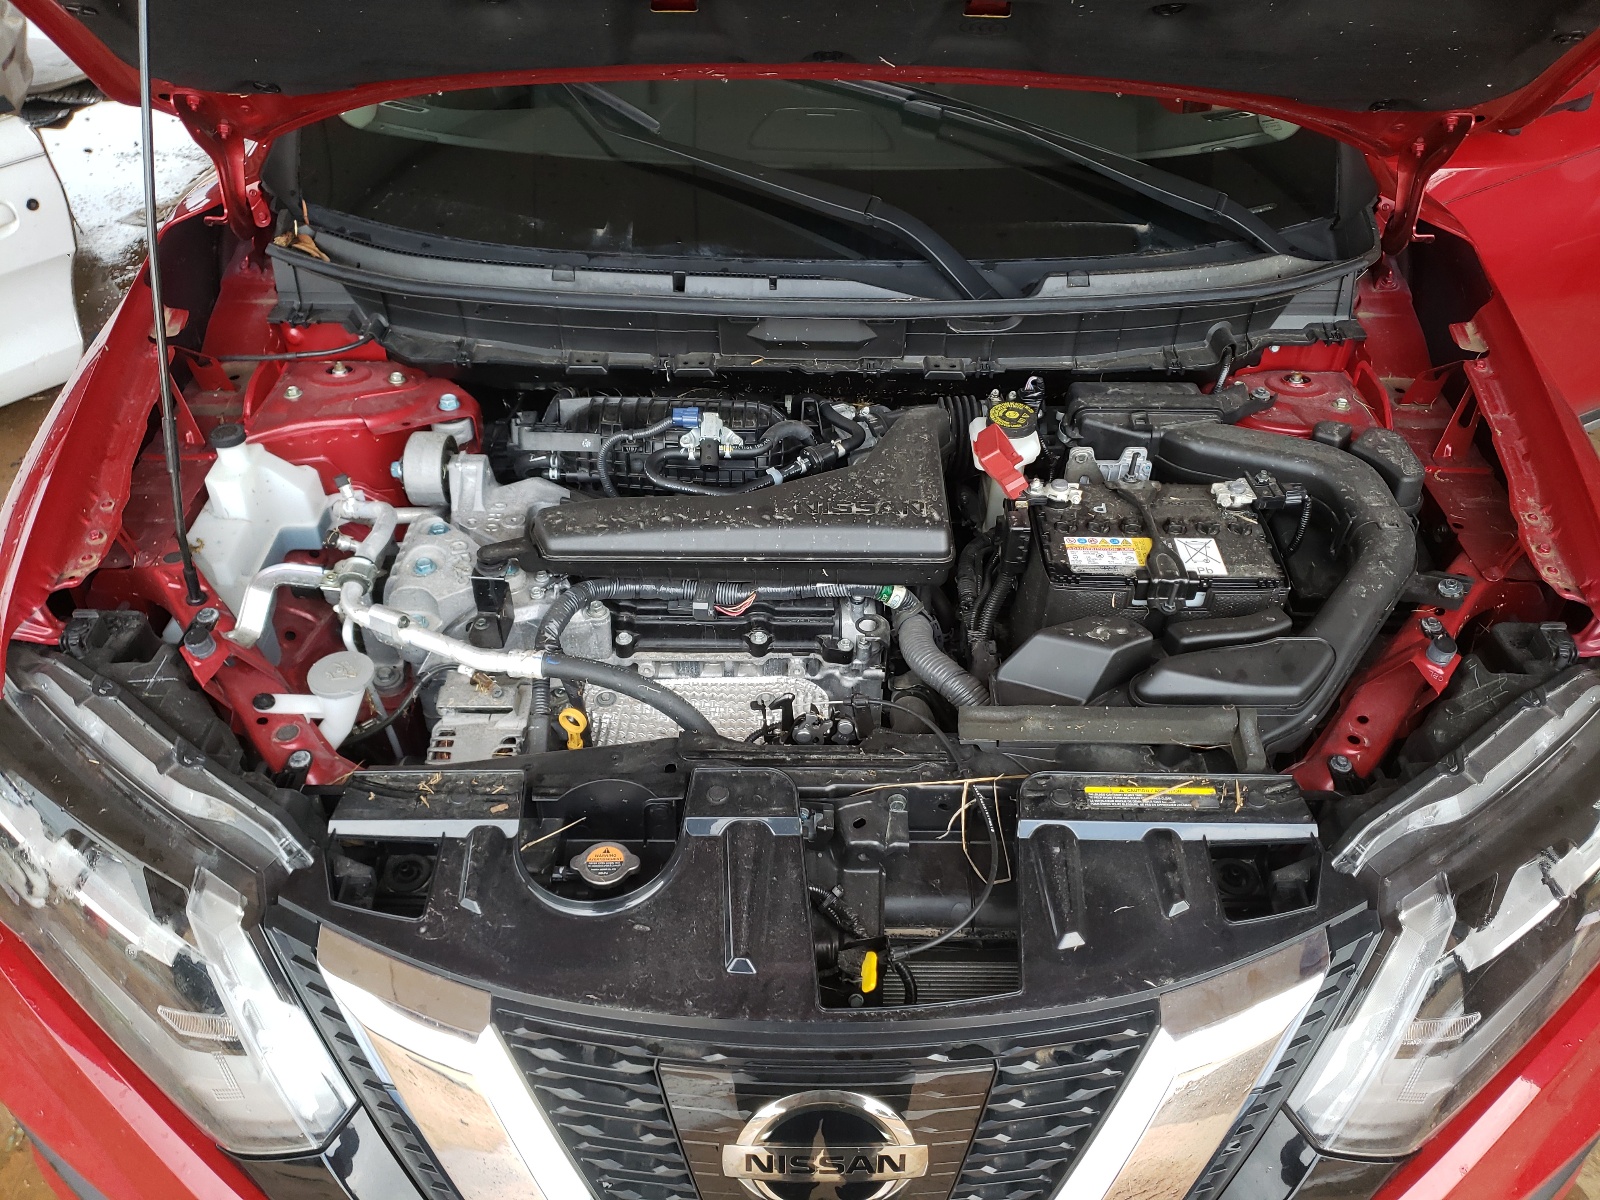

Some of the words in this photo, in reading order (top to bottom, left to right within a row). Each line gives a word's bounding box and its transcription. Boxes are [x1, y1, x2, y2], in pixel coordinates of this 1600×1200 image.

[793, 501, 928, 517] NISSAN
[1197, 566, 1214, 574] Pb
[745, 1153, 907, 1175] NISSAN
